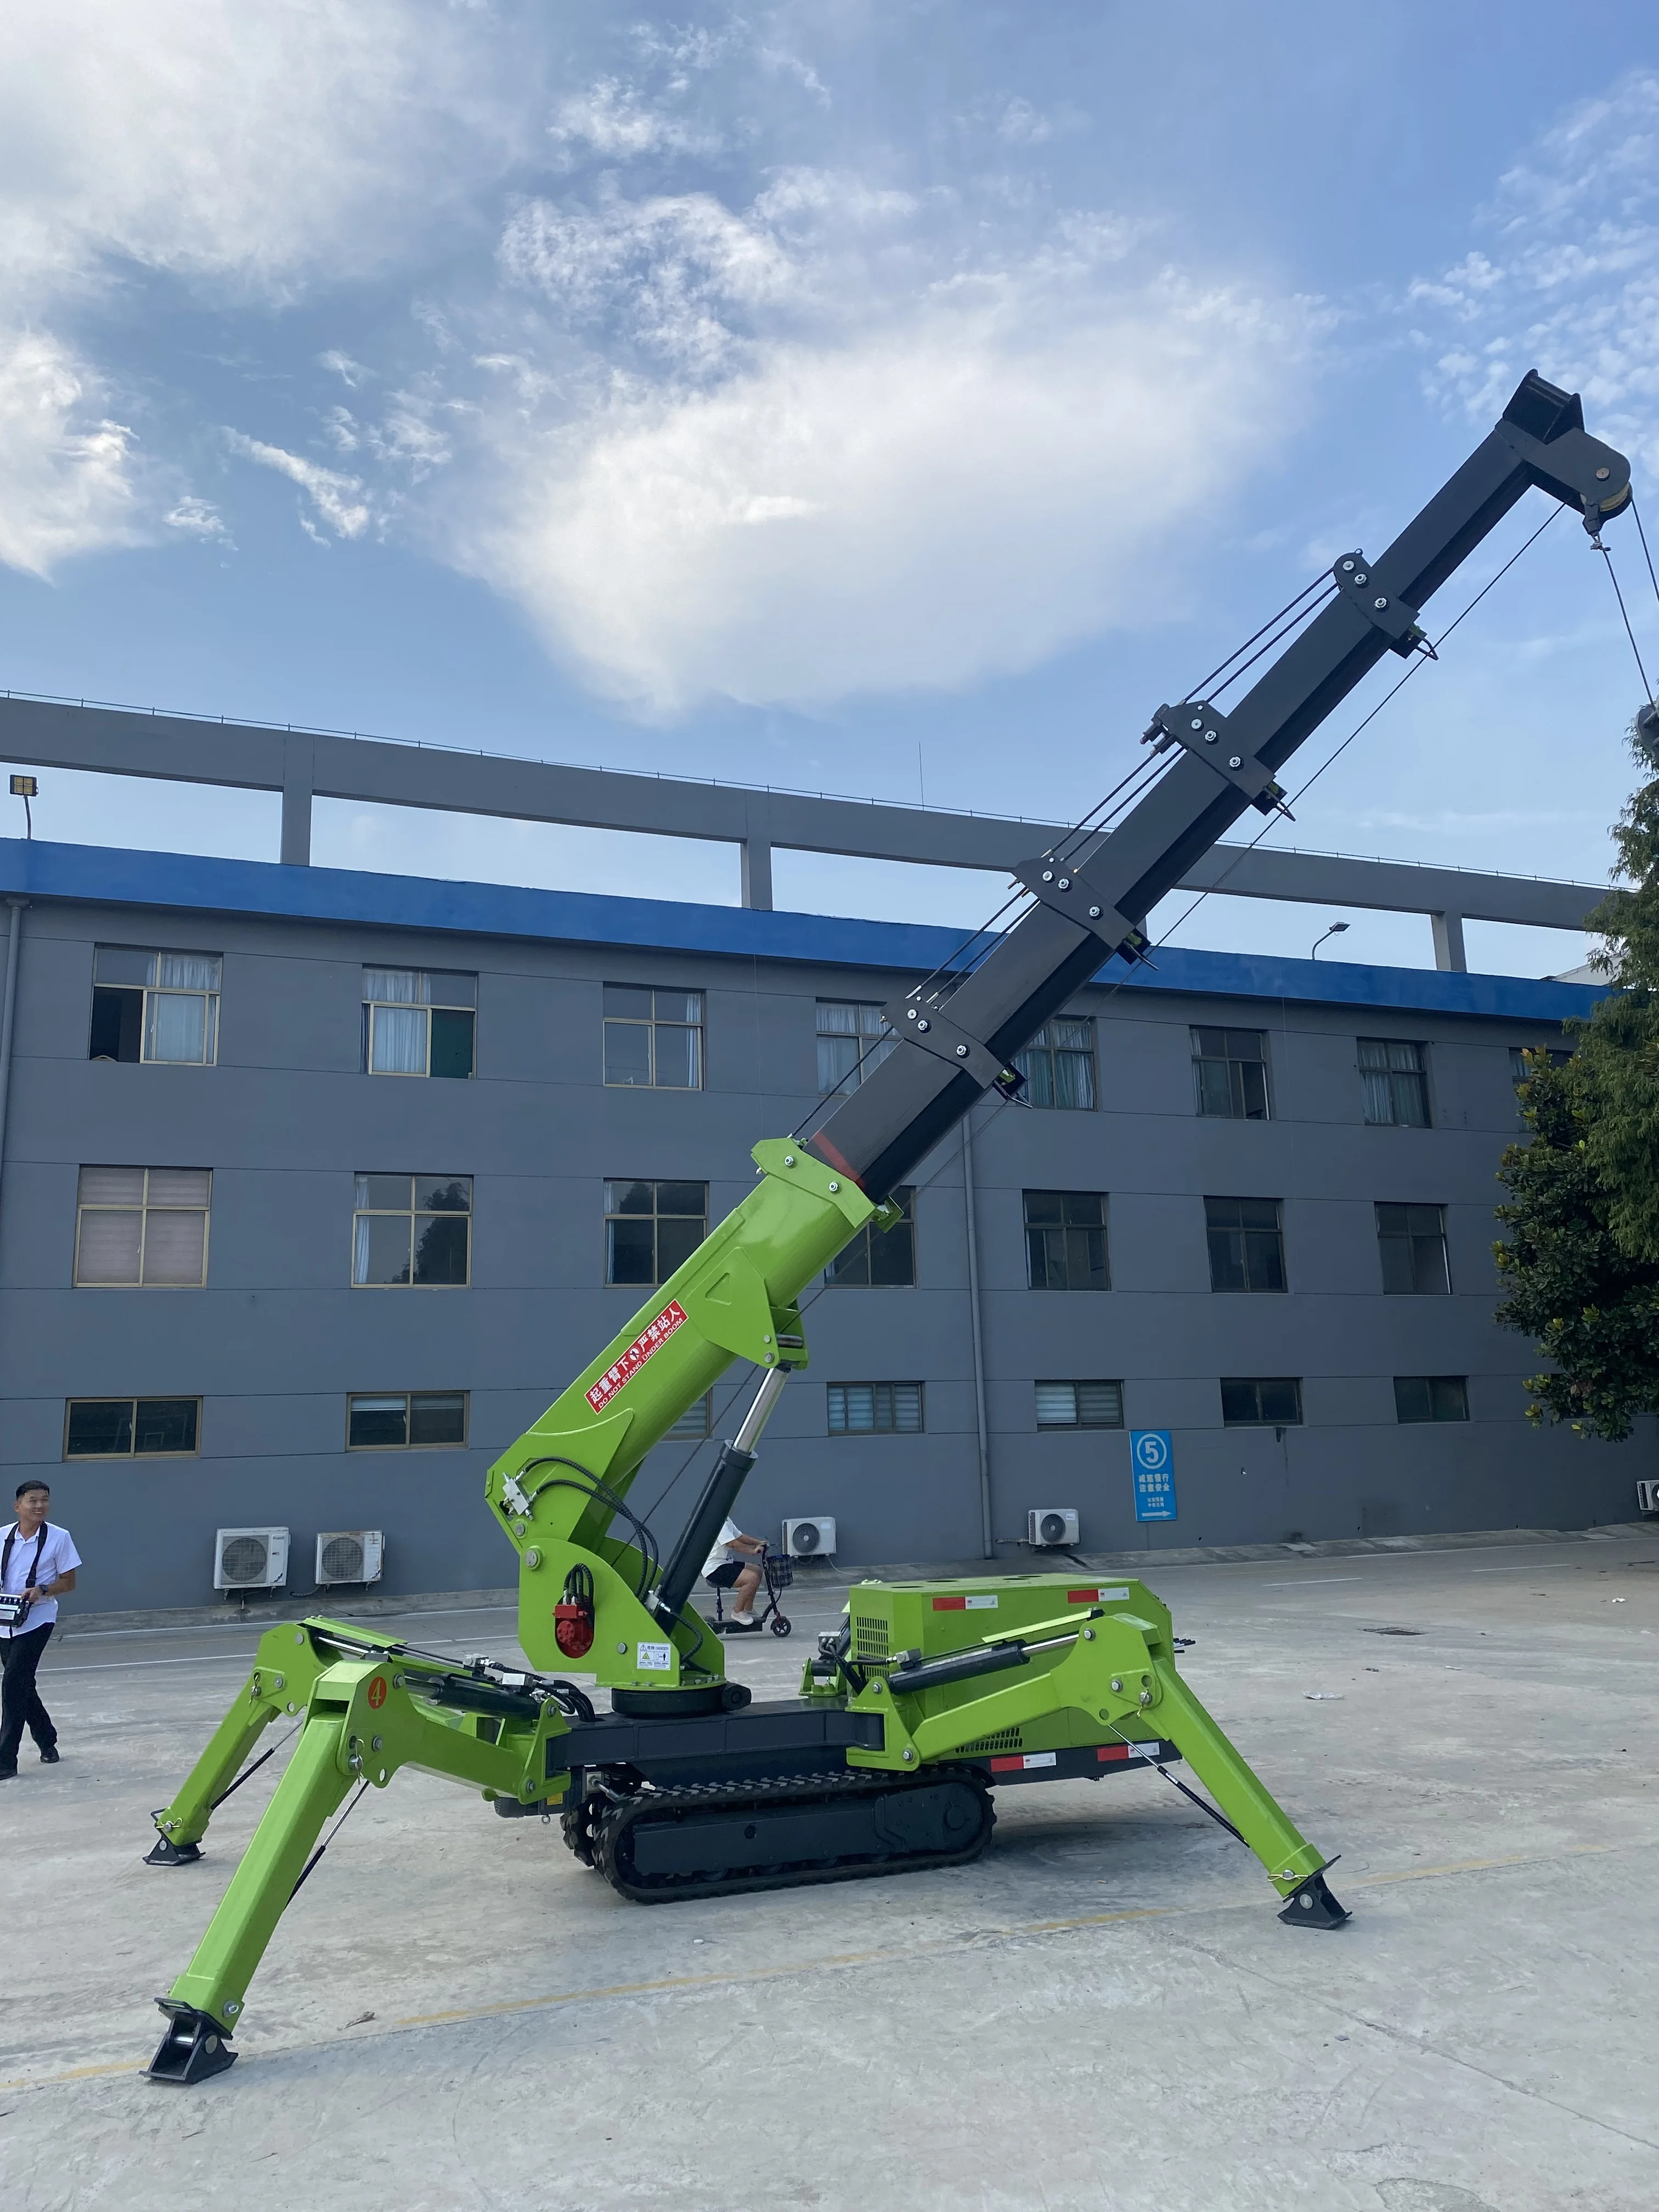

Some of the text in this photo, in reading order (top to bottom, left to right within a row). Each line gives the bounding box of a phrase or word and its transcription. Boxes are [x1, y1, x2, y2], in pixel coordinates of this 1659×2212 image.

[589, 1307, 680, 1404] 起重臂下 严禁站人
[598, 1317, 684, 1409] DO NOT STAND UNDER BOOM
[1144, 1441, 1159, 1463] 5
[371, 1679, 382, 1706] 4
